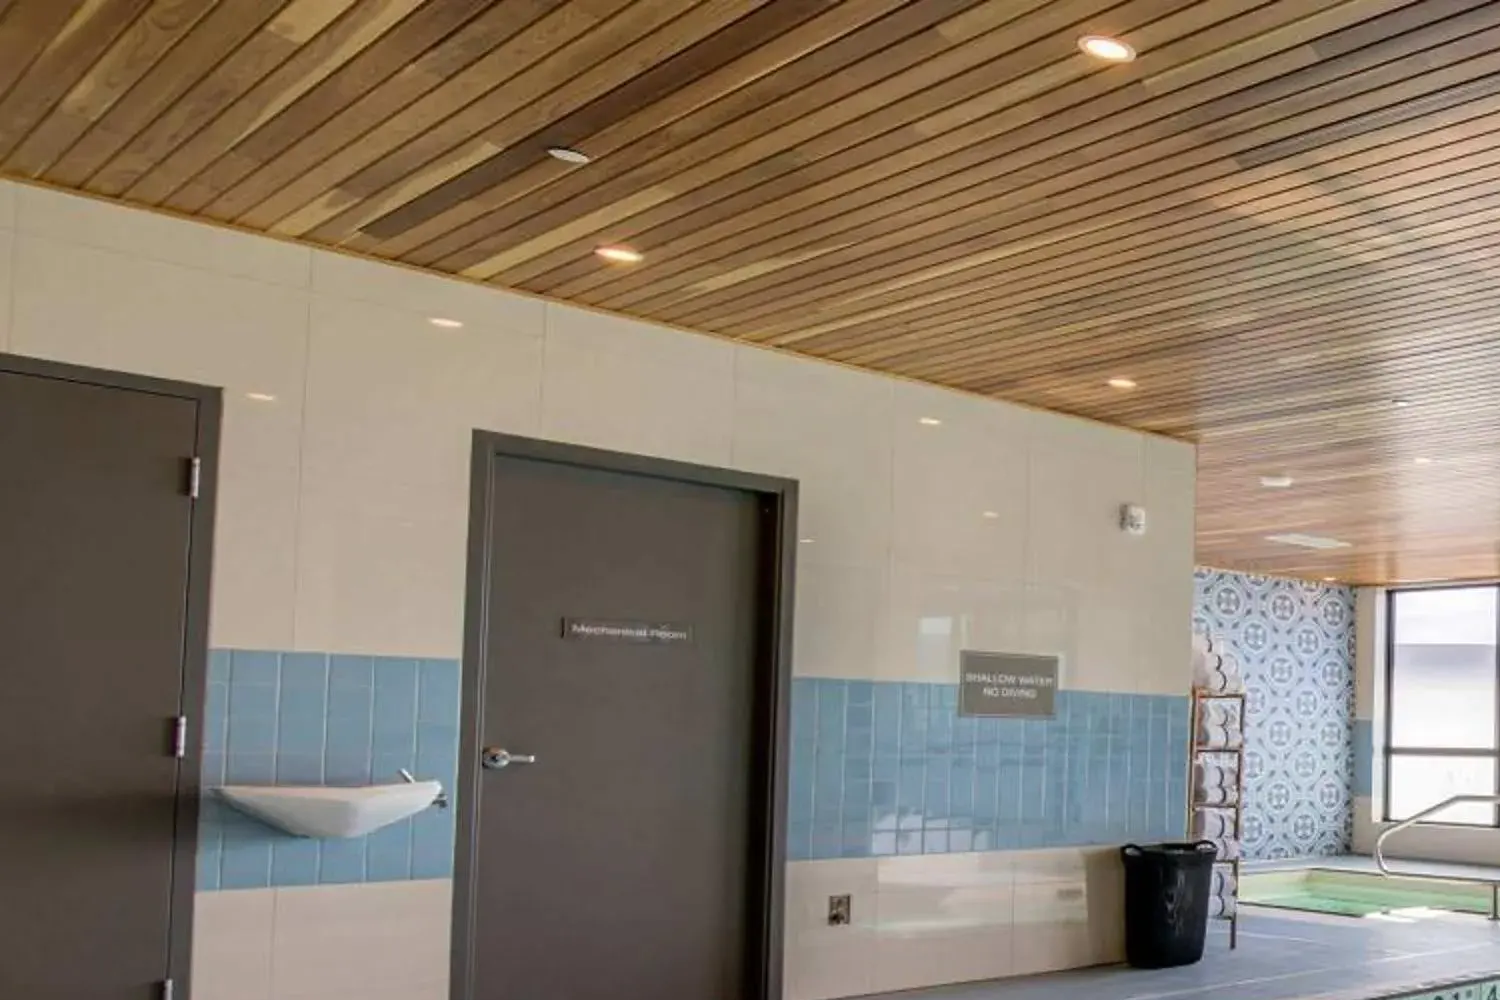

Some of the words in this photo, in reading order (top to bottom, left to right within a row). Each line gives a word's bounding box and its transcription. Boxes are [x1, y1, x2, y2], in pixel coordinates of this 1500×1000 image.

[965, 673, 1016, 685] SHALLOW
[1018, 676, 1053, 687] WATER
[983, 687, 999, 697] NO
[1001, 688, 1037, 699] DIVING
